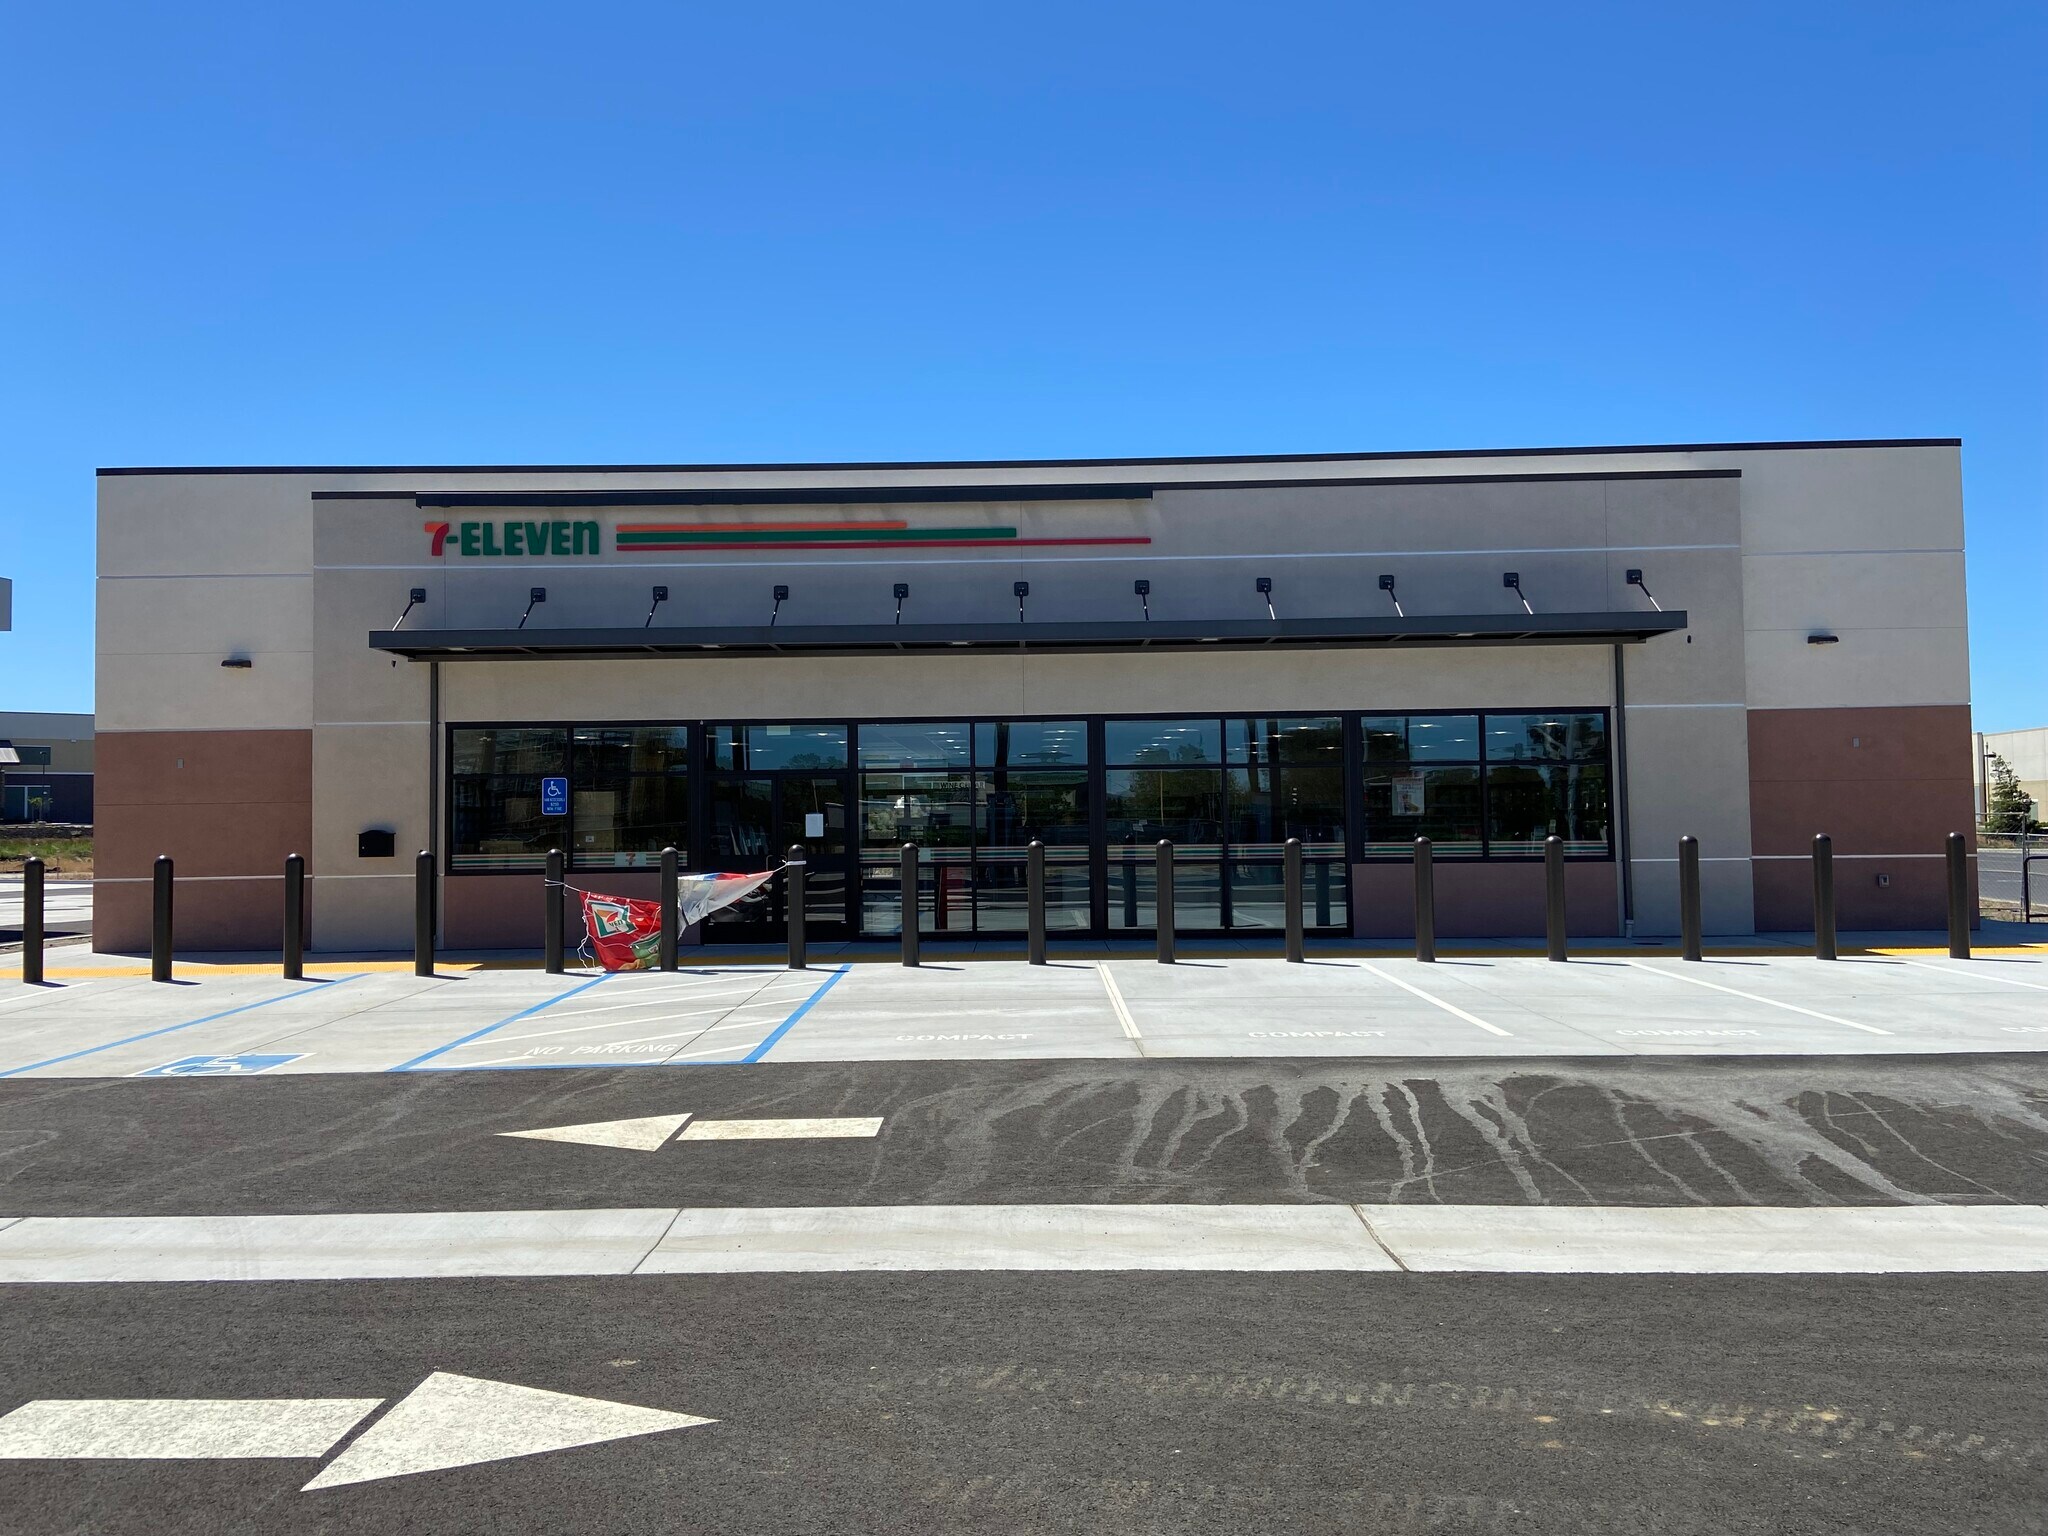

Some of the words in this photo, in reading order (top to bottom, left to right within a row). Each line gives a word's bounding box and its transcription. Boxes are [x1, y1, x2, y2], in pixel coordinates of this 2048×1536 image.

[896, 1033, 1034, 1041] COMPACT
[523, 1045, 564, 1056] NO
[570, 1043, 678, 1055] PARKING
